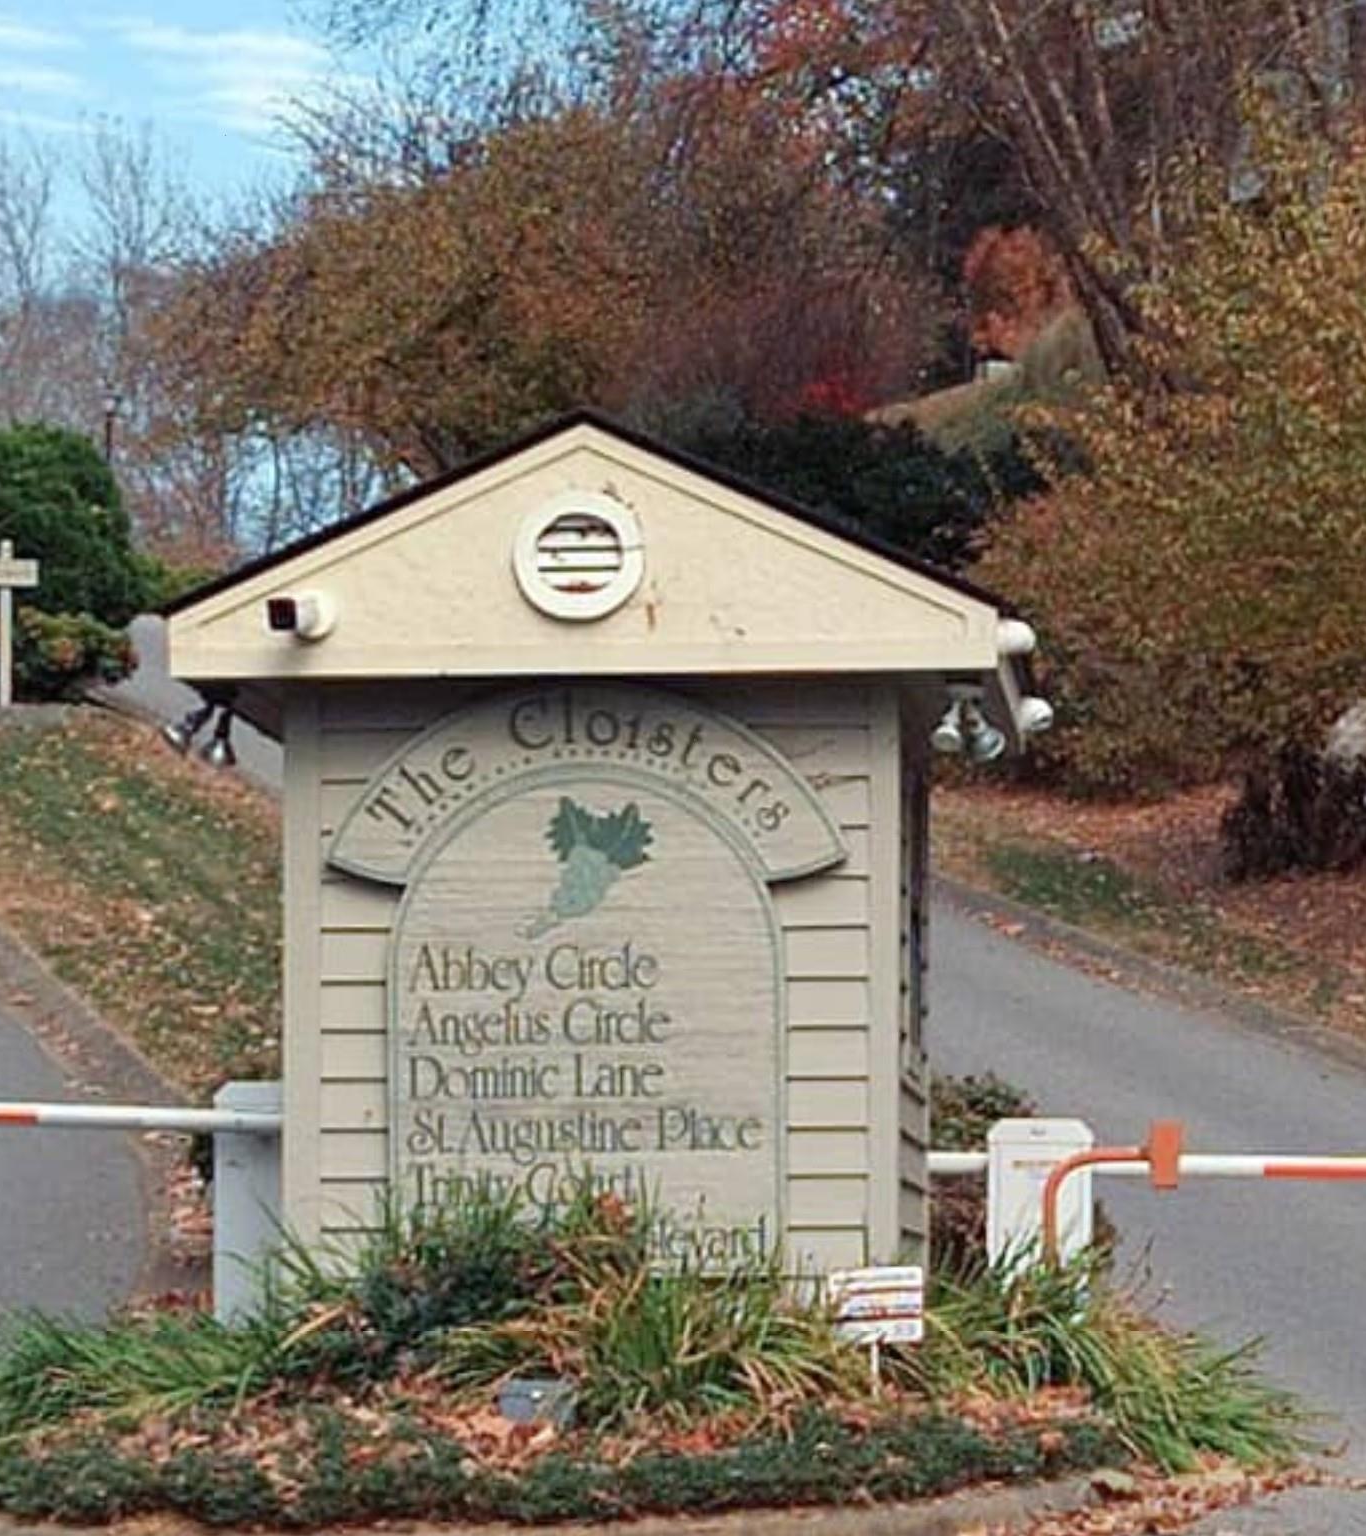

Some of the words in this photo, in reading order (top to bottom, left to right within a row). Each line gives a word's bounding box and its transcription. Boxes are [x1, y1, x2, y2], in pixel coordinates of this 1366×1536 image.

[366, 746, 476, 832] The
[508, 689, 791, 832] Cloisters
[409, 943, 534, 996] Abbey
[545, 941, 659, 990] Circle
[408, 1000, 552, 1055] Angelus
[563, 997, 671, 1046] Circle
[408, 1055, 560, 1099] Dominic
[574, 1053, 664, 1097] Lane
[462, 1109, 642, 1166] Augustine
[656, 1105, 762, 1151] Place
